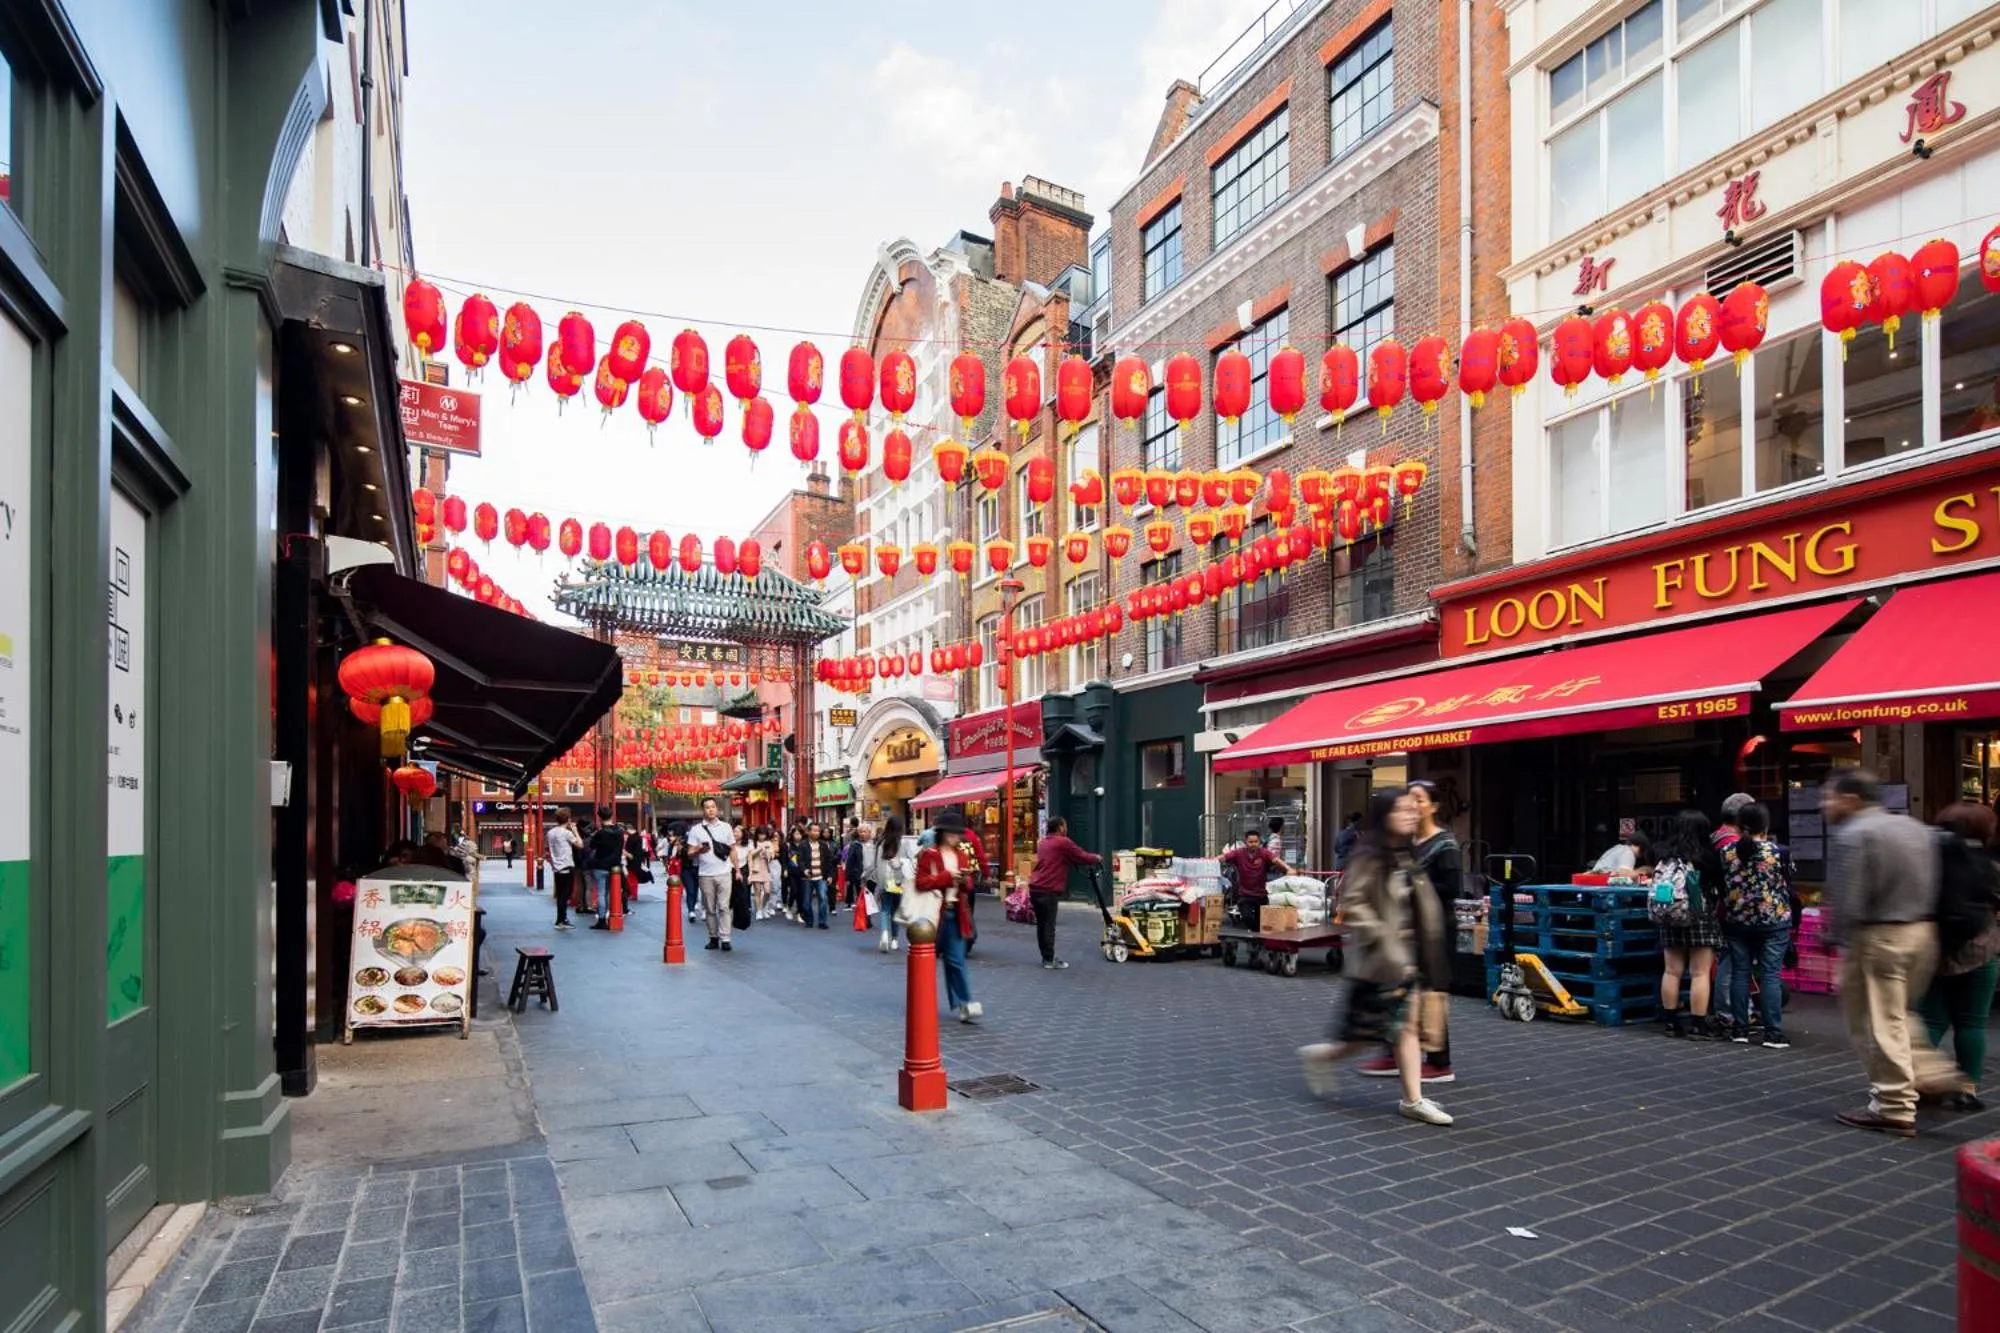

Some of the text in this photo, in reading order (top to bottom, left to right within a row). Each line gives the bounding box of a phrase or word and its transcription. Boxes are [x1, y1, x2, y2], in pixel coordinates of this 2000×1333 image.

[421, 408, 477, 427] Man & Mary's
[438, 420, 459, 431] Team
[418, 431, 425, 439] &
[426, 433, 453, 445] Beauty
[1463, 486, 2000, 646] LOON FUNG S
[679, 642, 739, 662] 安民泰國
[1657, 697, 1738, 720] EST. 1965
[1794, 698, 1968, 725] www.loonfung.co.uk
[1310, 730, 1473, 760] THE FAR EASTERN FOOD MARKET
